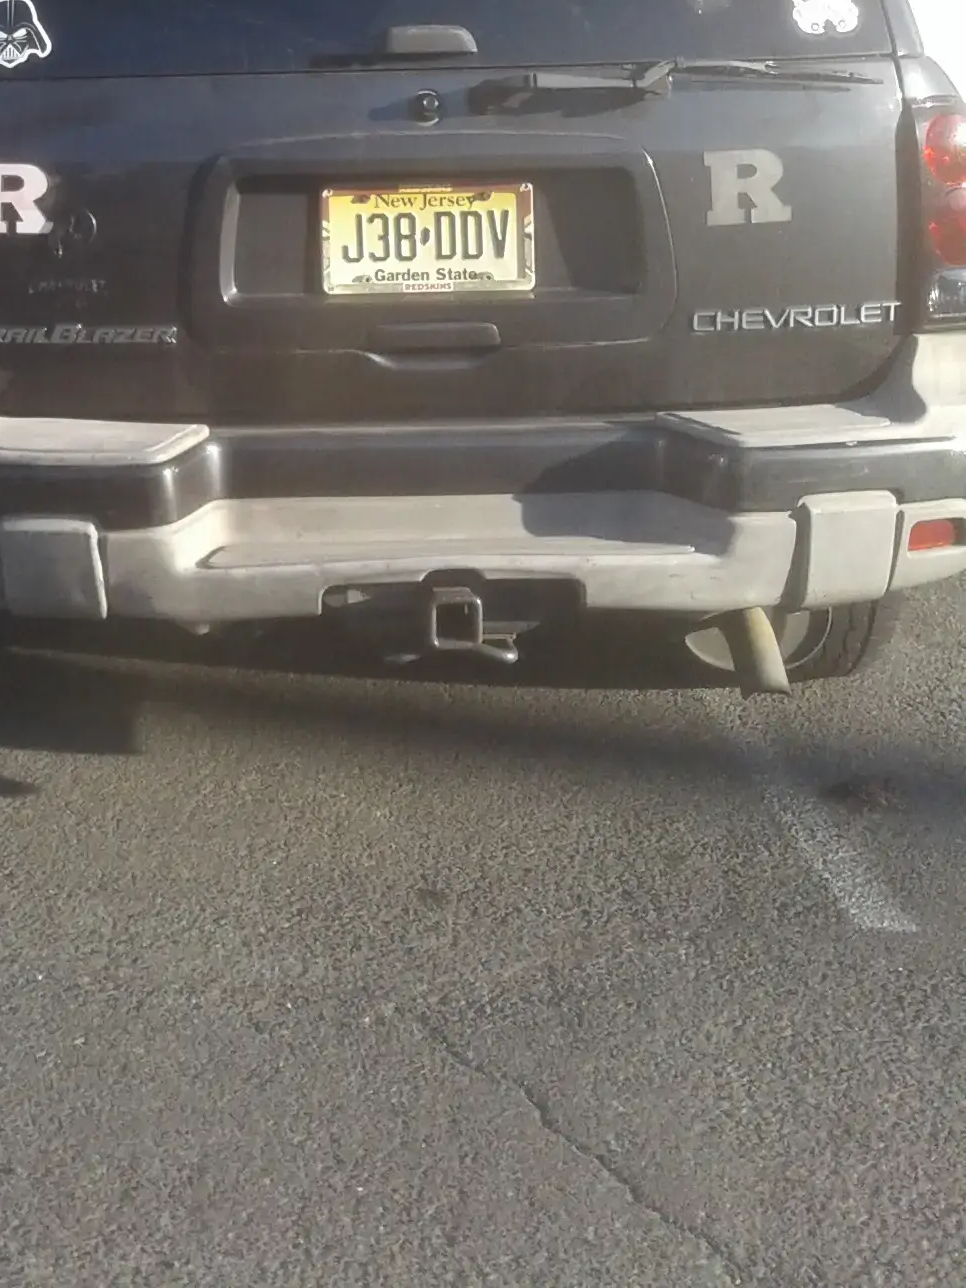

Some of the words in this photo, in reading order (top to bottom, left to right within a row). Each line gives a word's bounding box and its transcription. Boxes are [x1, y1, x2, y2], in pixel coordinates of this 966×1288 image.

[703, 148, 793, 227] R
[374, 194, 417, 209] New
[419, 193, 475, 210] Jersey
[374, 268, 430, 283] Garden
[435, 267, 478, 282] State
[692, 300, 902, 332] CHEVROLET
